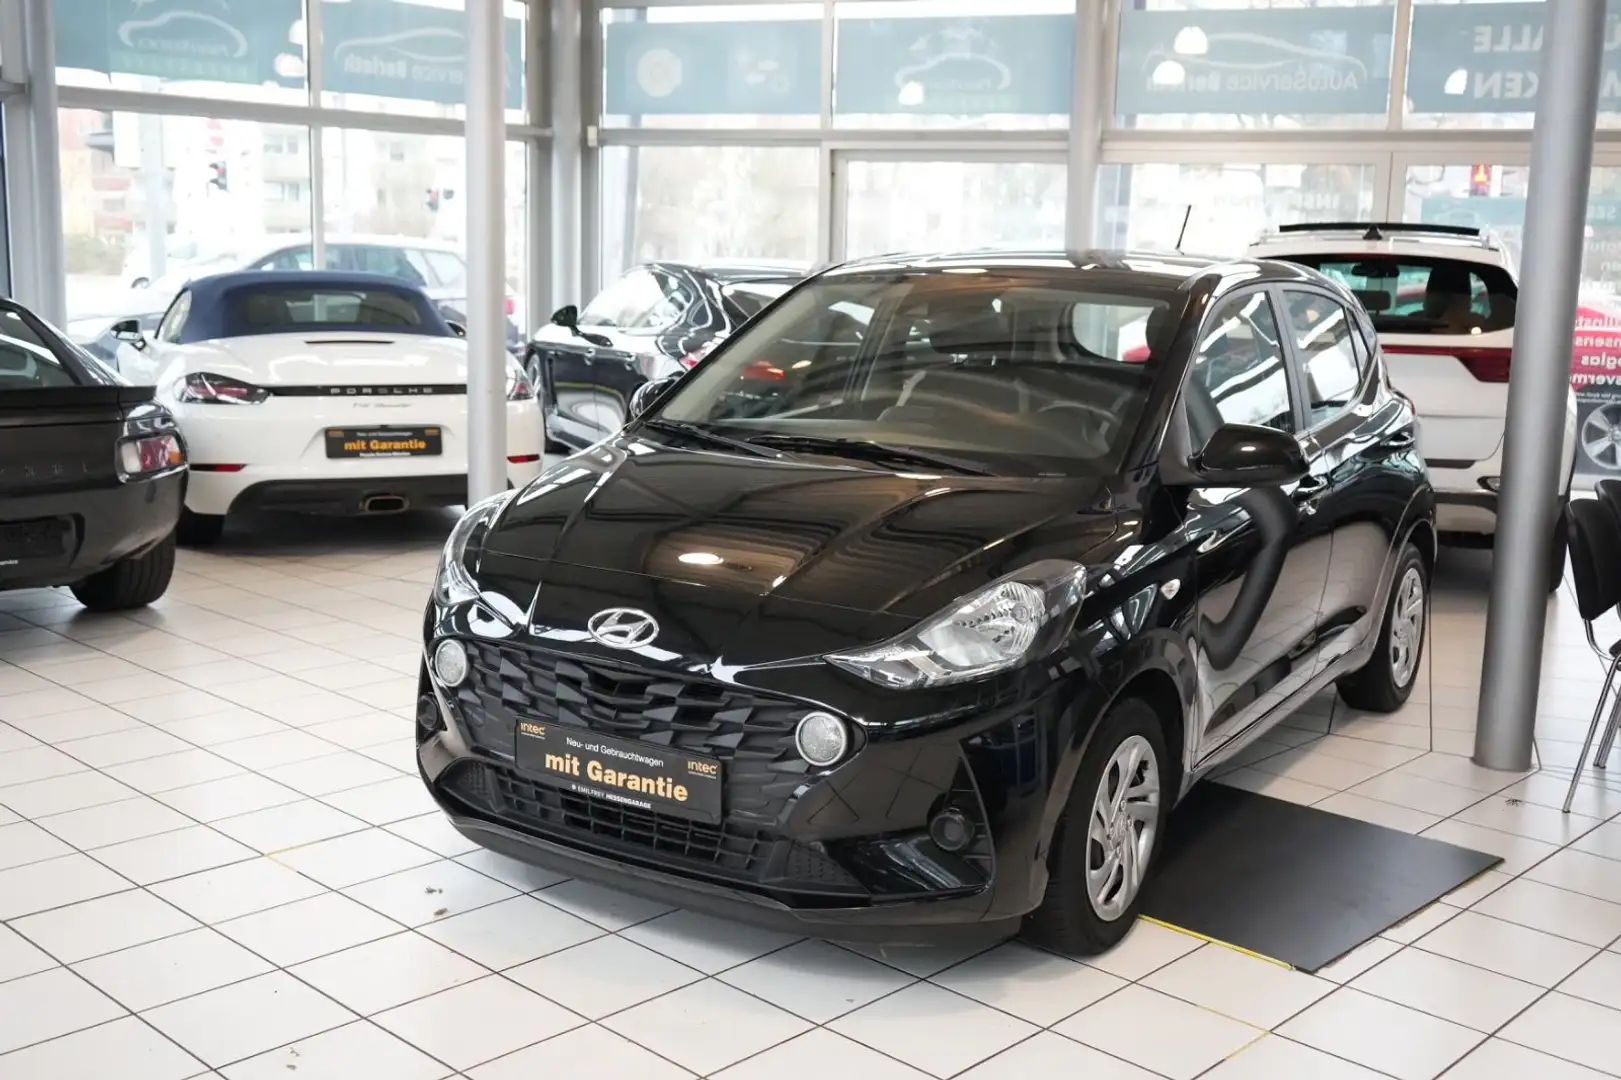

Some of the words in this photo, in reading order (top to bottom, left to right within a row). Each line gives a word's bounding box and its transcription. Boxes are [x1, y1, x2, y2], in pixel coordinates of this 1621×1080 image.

[330, 387, 433, 395] PORSCHE
[344, 439, 367, 450] mit
[369, 438, 426, 450] Garantie
[566, 736, 584, 749] Neu-
[585, 742, 599, 753] und
[600, 745, 664, 768] Gebrauchtwagen
[687, 760, 717, 775] intec
[545, 752, 580, 777] mit
[586, 760, 689, 802] Garantie
